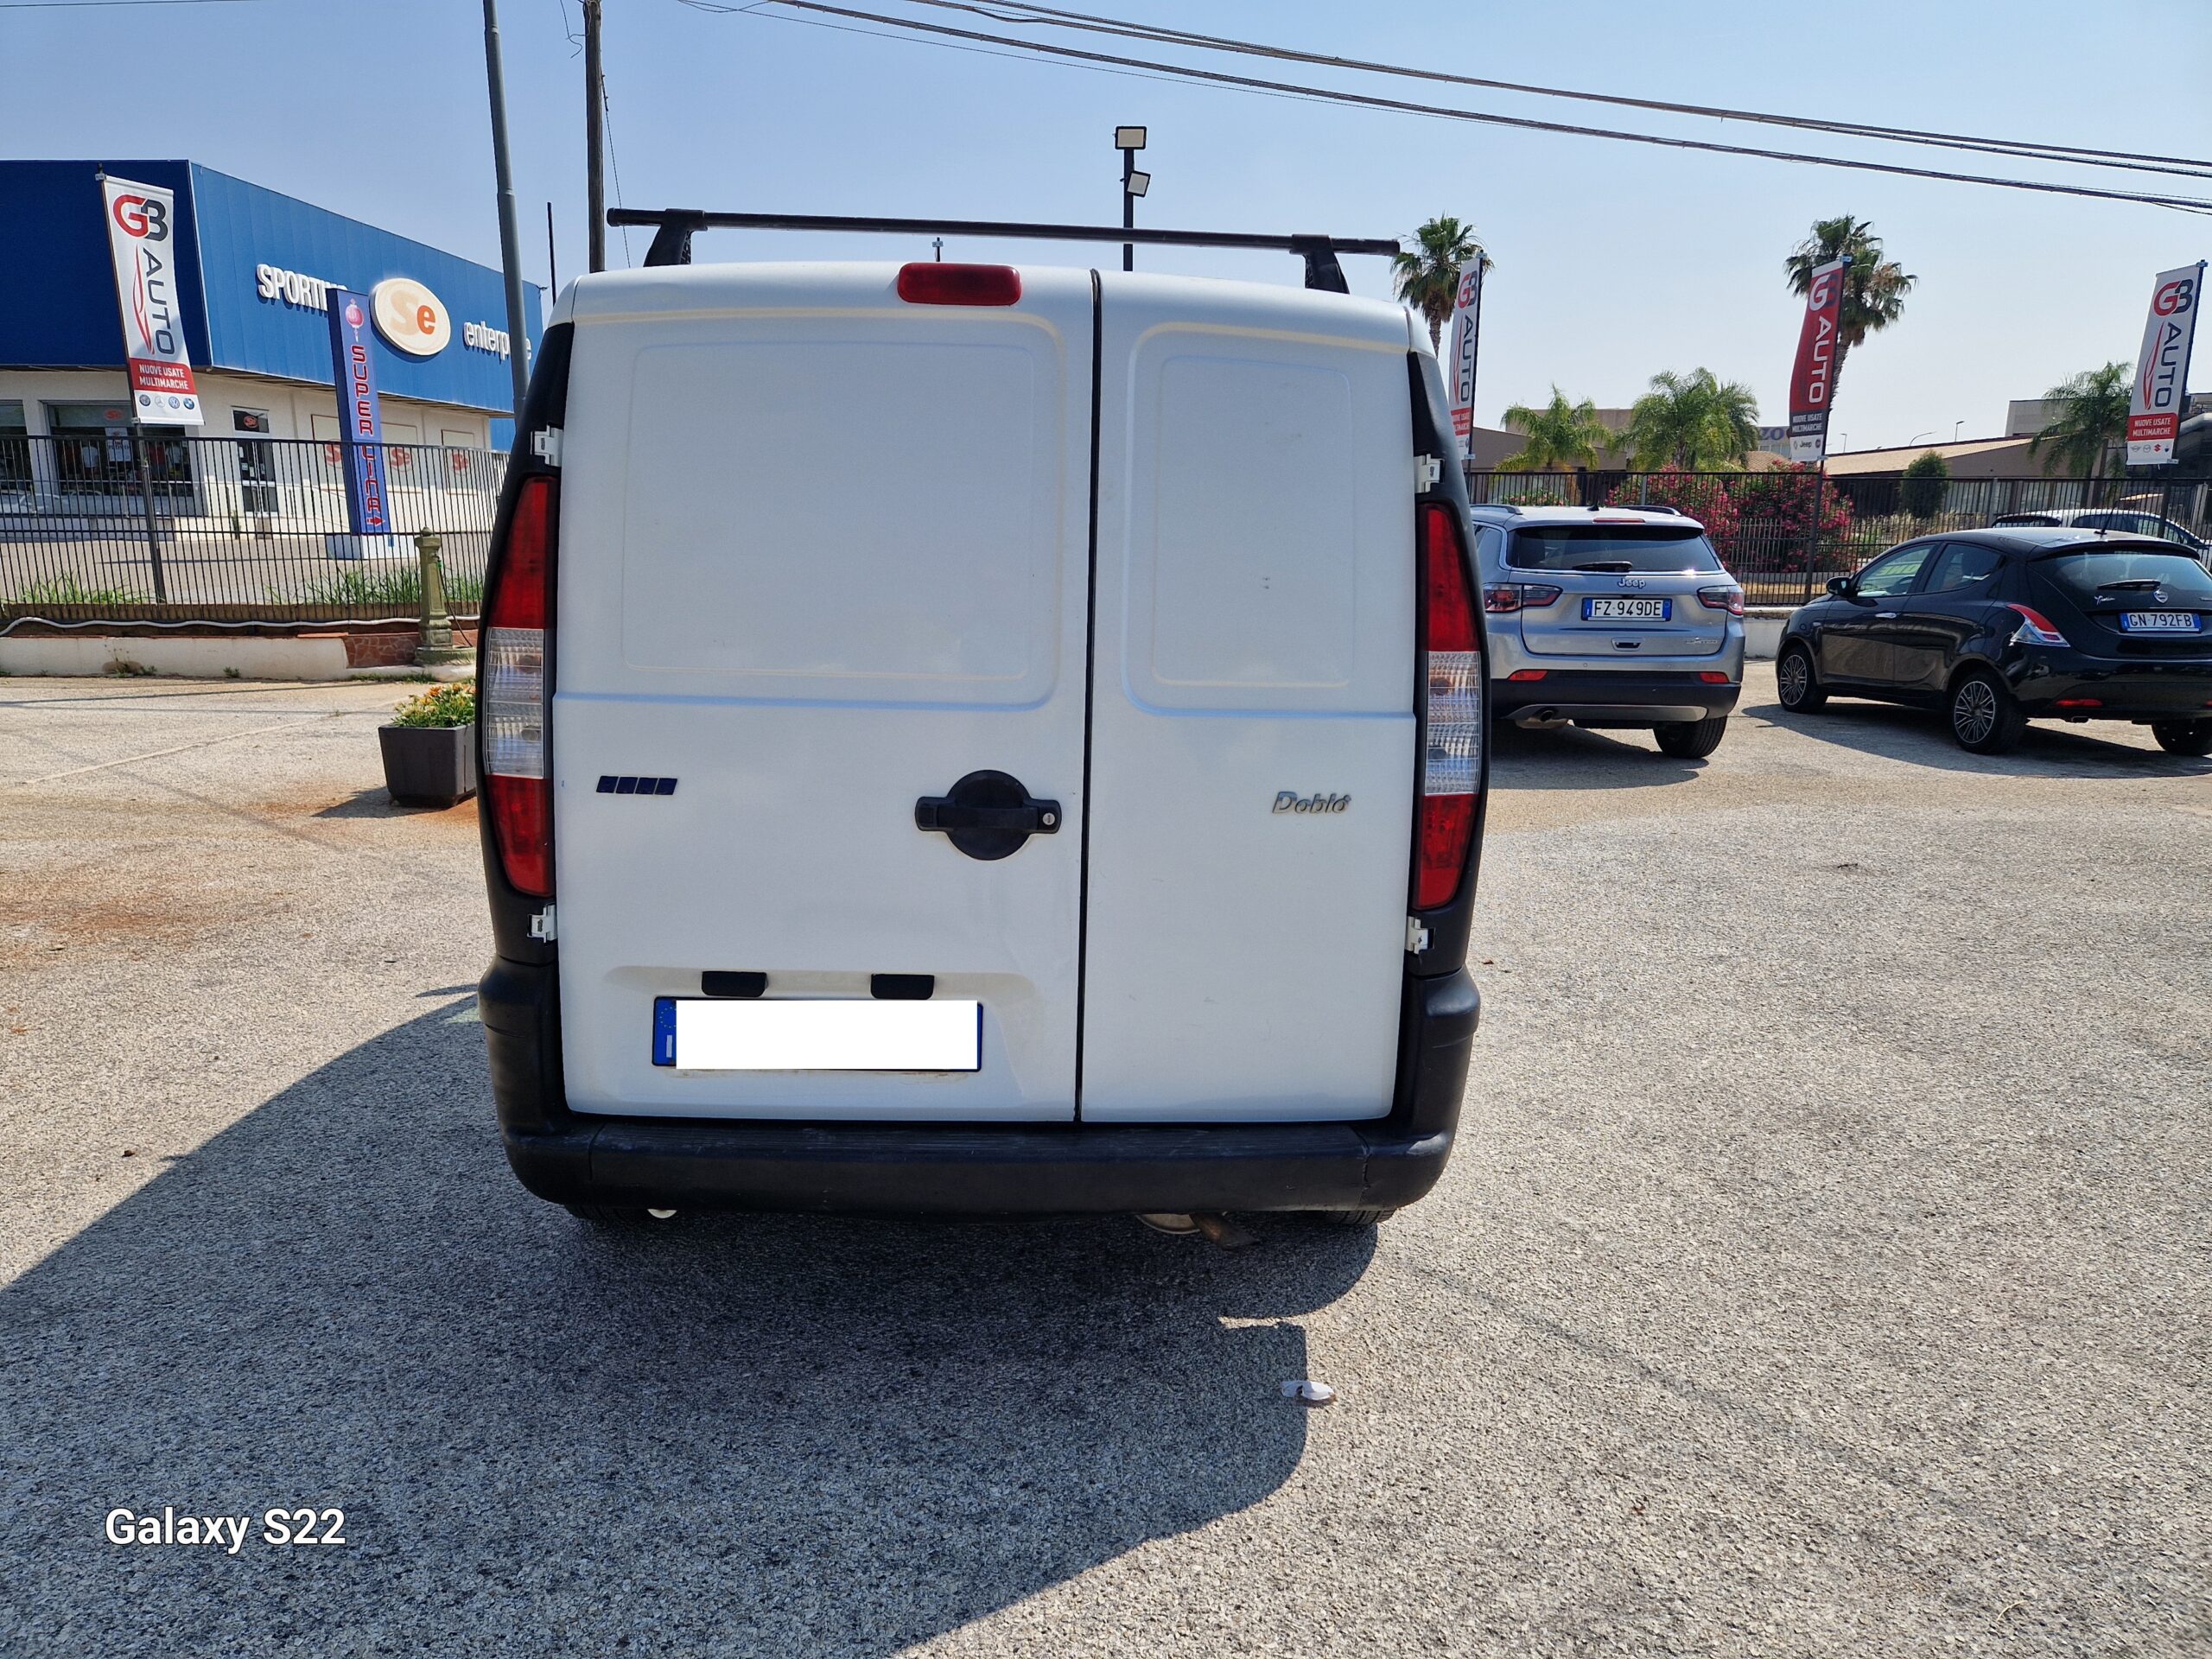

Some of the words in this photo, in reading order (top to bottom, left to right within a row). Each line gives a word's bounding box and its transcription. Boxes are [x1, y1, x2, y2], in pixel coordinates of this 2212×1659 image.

[143, 247, 175, 355] AUTO
[389, 289, 435, 335] Se
[1460, 314, 1474, 403] AUTO
[1808, 315, 1833, 404] AUTO
[2154, 321, 2183, 408] AUTO
[138, 365, 162, 376] NUOVE
[163, 367, 185, 378] USATE
[138, 377, 189, 391] MULTIMARCHE
[351, 345, 373, 436] SUPER
[1808, 413, 1822, 422] USATE
[2134, 418, 2152, 428] NUOVE
[2153, 416, 2171, 426] USATE
[2133, 427, 2171, 437] MULTIMARCHE
[1618, 577, 1646, 589] Jeep
[1594, 601, 1612, 616] FZ
[1617, 601, 1662, 617] 949DE
[2129, 614, 2147, 626] GN
[2150, 614, 2193, 625] 792FB
